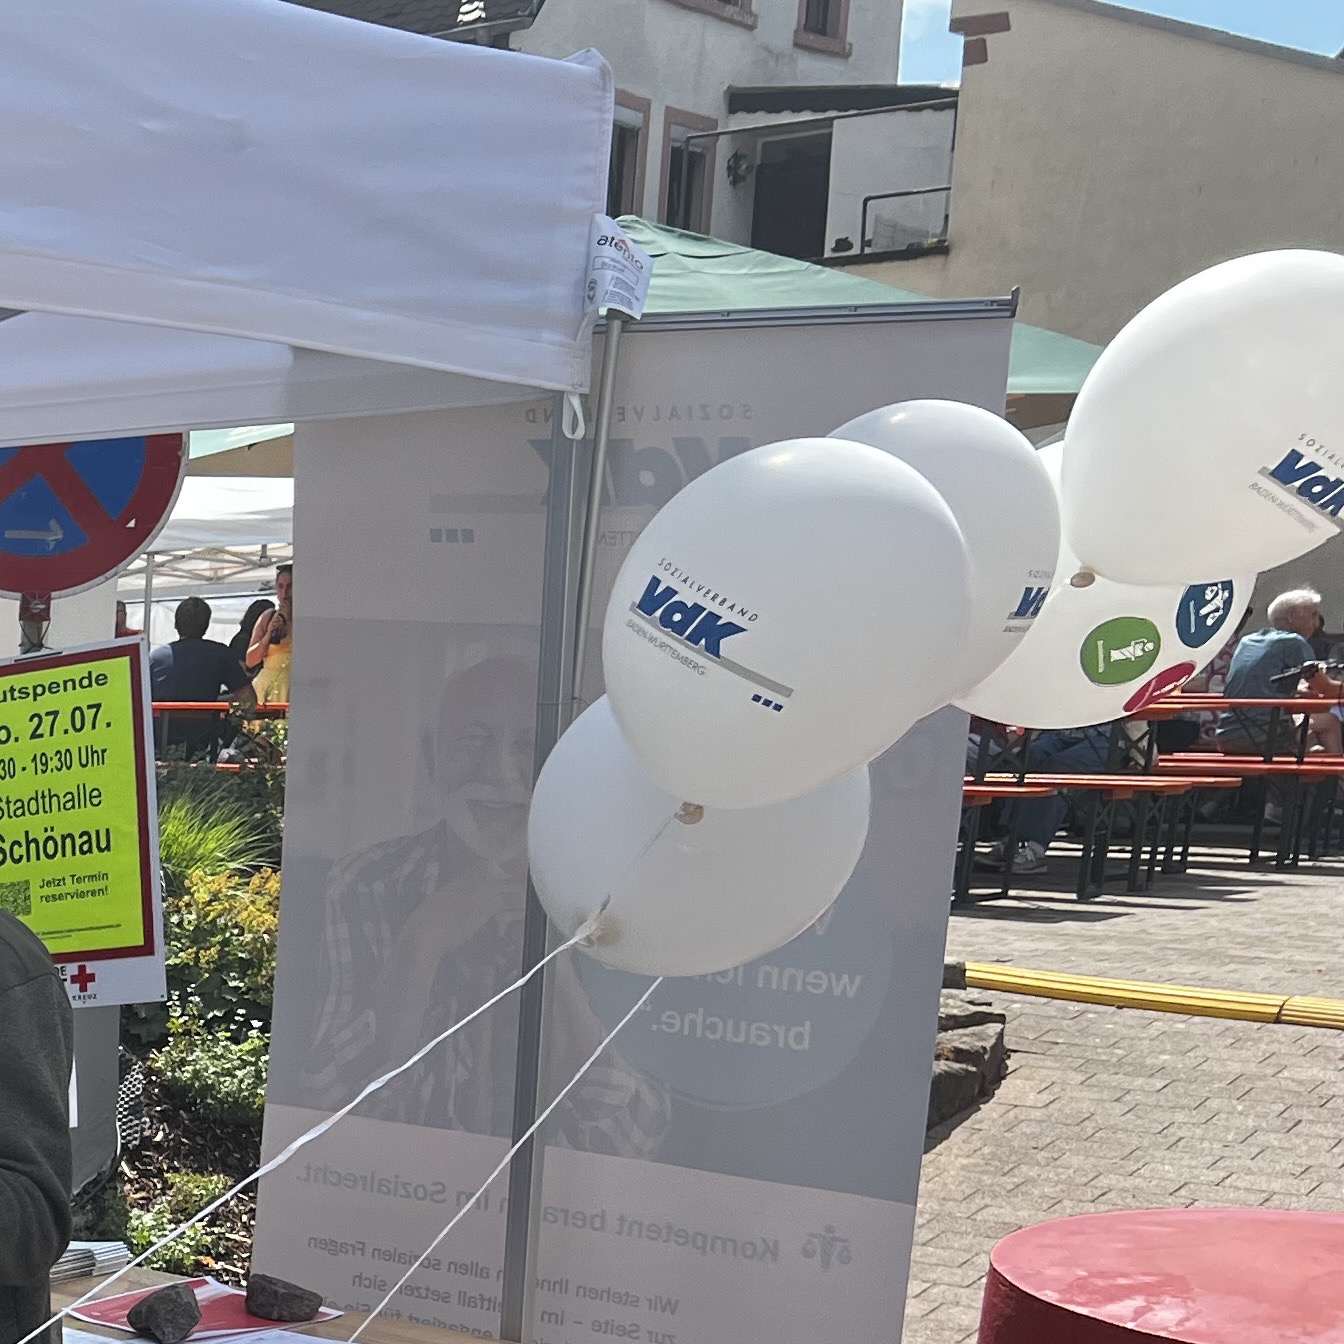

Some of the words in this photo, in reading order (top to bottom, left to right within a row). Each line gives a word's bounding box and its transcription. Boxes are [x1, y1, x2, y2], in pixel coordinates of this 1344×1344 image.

[658, 558, 758, 622] SOZIALVERBAND
[636, 575, 748, 659] VdK
[28, 702, 112, 740] 27.07.
[31, 748, 73, 775] 19:30
[78, 744, 107, 768] Uhr
[39, 875, 66, 889] Jetzt
[69, 871, 109, 886] Termin
